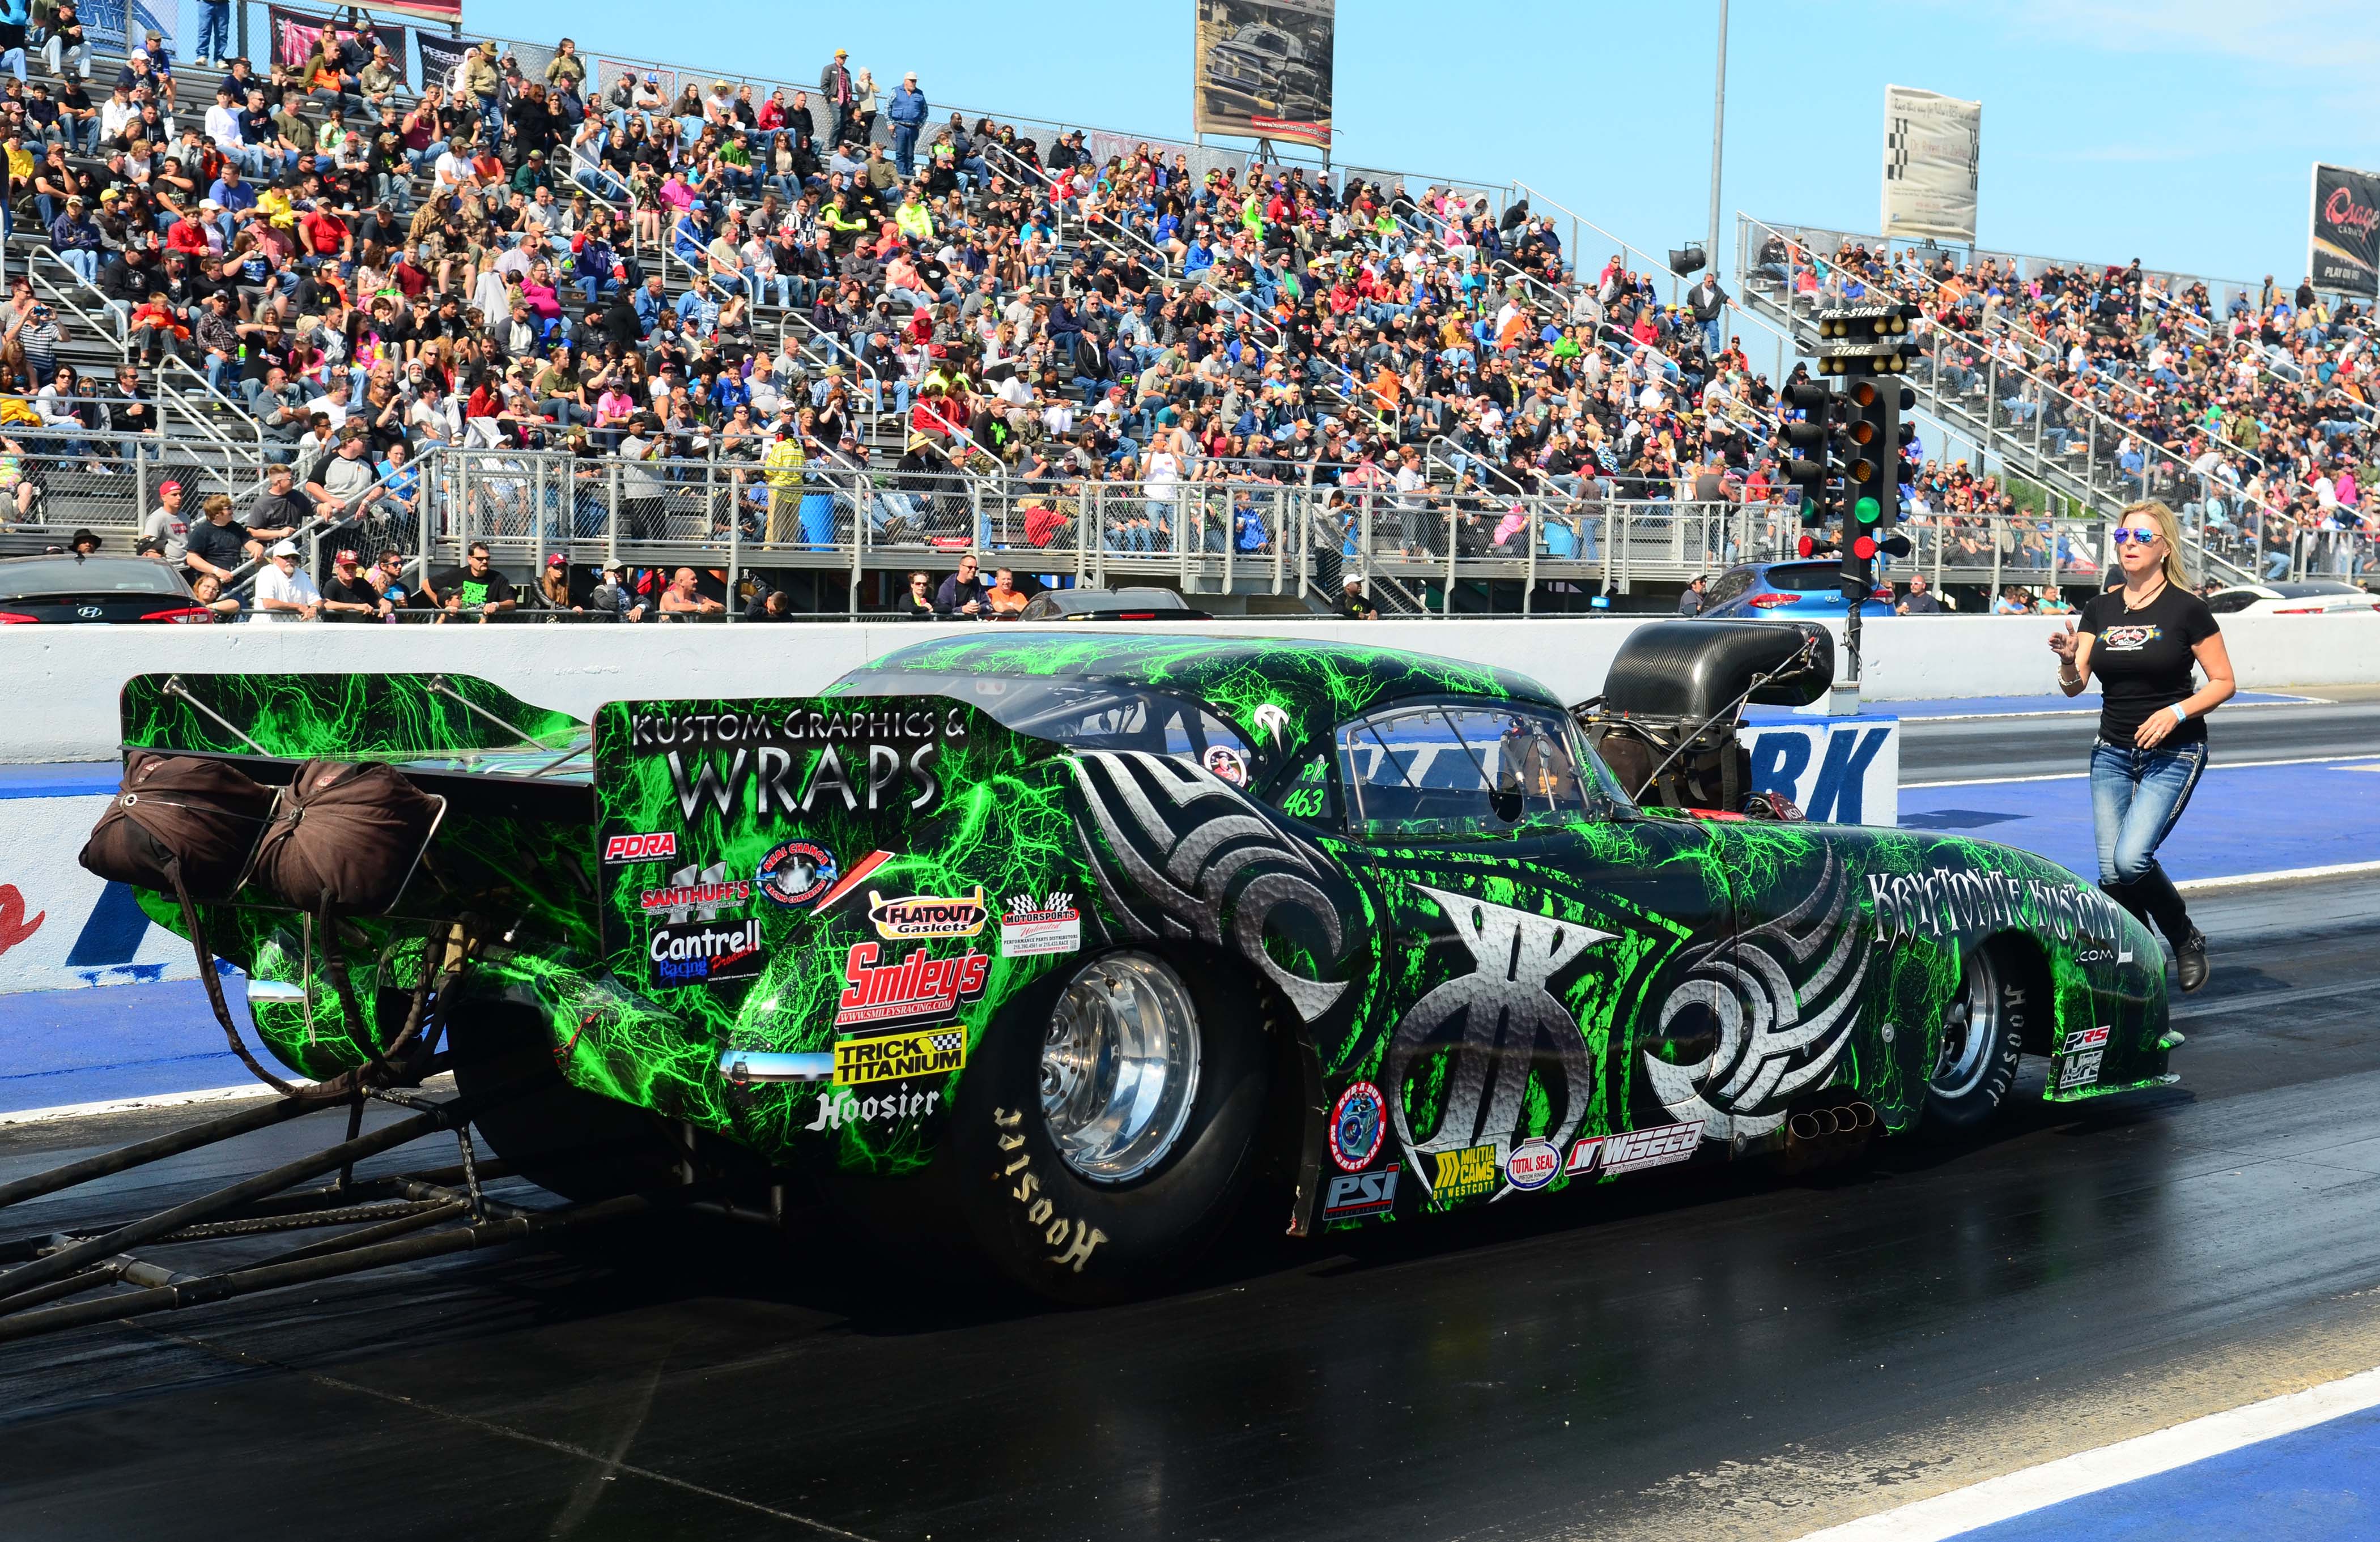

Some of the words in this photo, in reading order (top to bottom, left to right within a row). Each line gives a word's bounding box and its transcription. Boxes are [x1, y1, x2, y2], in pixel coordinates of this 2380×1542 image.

[2326, 187, 2379, 245] Osage
[2324, 266, 2342, 278] PLAY
[1818, 306, 1889, 319] PRE-STAGE
[1831, 346, 1872, 355] STAGE
[632, 713, 772, 746] KUSTOM
[784, 708, 934, 740] GRAPHICS
[945, 709, 966, 737] &
[667, 743, 934, 821] WRAPS
[1284, 789, 1324, 816] 463
[1784, 808, 1802, 820] MSD
[605, 832, 676, 860] PDRA
[764, 847, 788, 872] NEAL
[789, 843, 828, 866] CHANCE
[641, 880, 750, 909] SANTHUFF'S
[766, 883, 788, 902] RACING
[788, 879, 826, 904] CONVERTERS
[888, 904, 975, 926] FLATOUT
[1006, 910, 1075, 923] MOTORSPORTS
[1867, 865, 2032, 954] KRYPTONITE
[651, 919, 760, 962] Cantrell
[898, 923, 968, 933] Gaskets
[660, 955, 708, 979] Racing
[711, 943, 757, 973] Products
[840, 942, 988, 1009] Smiley's
[840, 999, 952, 1023] WWW.SMILEYSRACING.COM
[838, 1038, 923, 1064] TRICK
[1987, 985, 2027, 1107] Hoosier
[838, 1050, 962, 1082] TITANIUM
[805, 1081, 940, 1131] Hoosier
[1461, 1145, 1495, 1165] MILITIA
[1512, 1157, 1533, 1174] TOTAL
[1536, 1154, 1554, 1170] SEAL
[1605, 1160, 1655, 1175] Performance
[1460, 1161, 1495, 1185] CAMS
[994, 1107, 1110, 1272] Hoosier
[1433, 1189, 1443, 1200] BY
[1448, 1181, 1494, 1198] WESTCOTT
